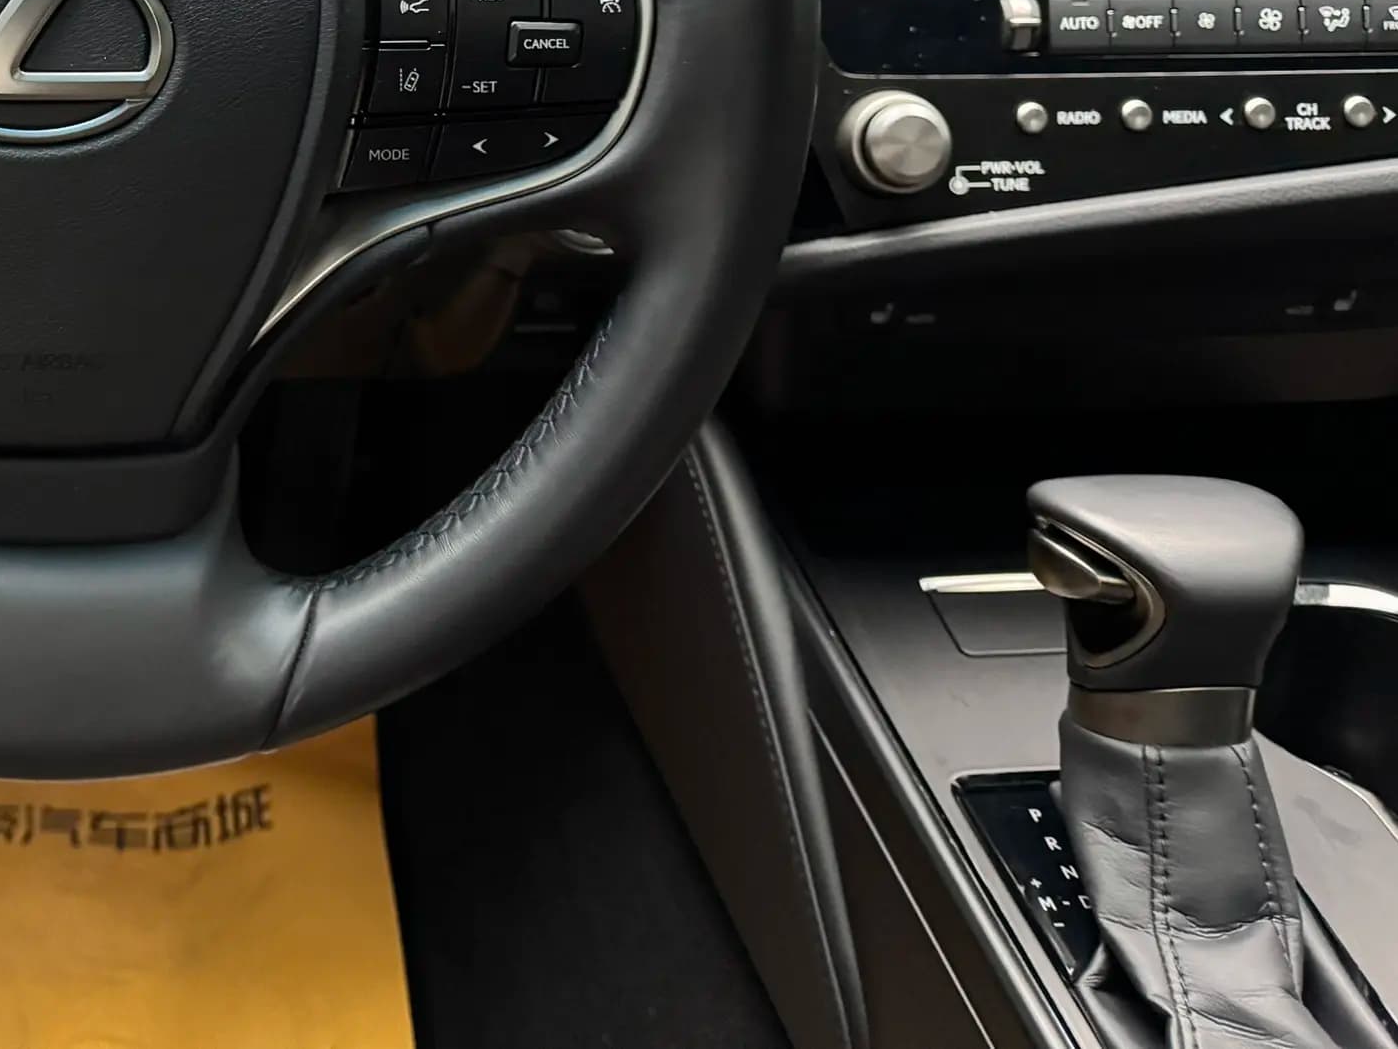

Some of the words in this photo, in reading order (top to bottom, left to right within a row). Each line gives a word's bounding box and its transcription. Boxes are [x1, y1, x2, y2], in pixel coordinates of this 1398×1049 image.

[1060, 16, 1100, 30] AUTO
[1135, 15, 1164, 29] OFF
[523, 38, 570, 50] CANCEL
[1162, 110, 1208, 124] MEDIA
[1296, 103, 1319, 116] CH
[1056, 110, 1102, 125] RADIO
[1285, 116, 1332, 131] TRACK
[368, 148, 410, 161] MODE
[990, 177, 1031, 192] TUNE
[1028, 808, 1043, 823] P
[1044, 836, 1062, 851] R
[1060, 865, 1079, 880] N
[1037, 895, 1058, 912] M
